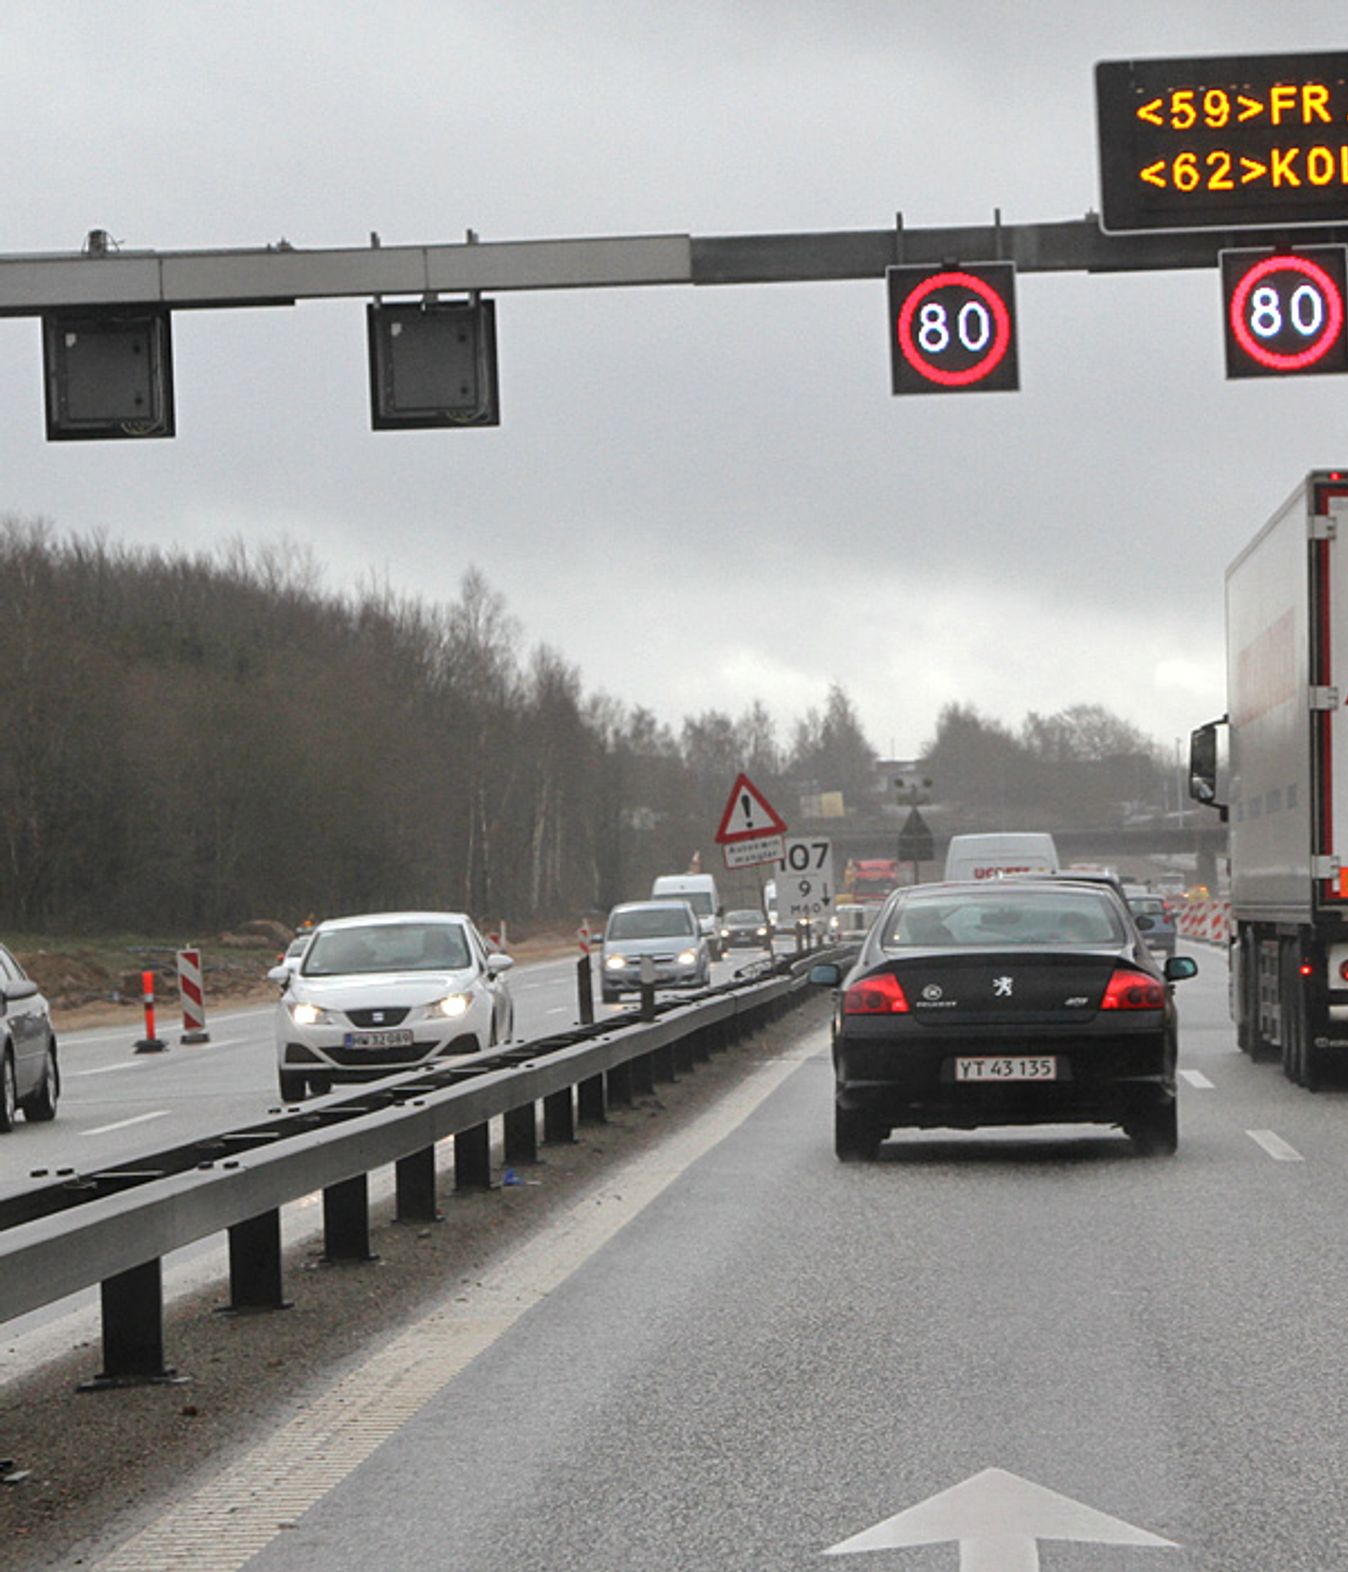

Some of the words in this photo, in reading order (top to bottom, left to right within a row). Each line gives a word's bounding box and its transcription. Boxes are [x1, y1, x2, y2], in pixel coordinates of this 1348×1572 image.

[918, 301, 990, 353] 80
[1250, 284, 1322, 337] 80
[799, 880, 812, 897] 9
[960, 1060, 985, 1077] YT
[990, 1060, 1013, 1076] 43
[1019, 1060, 1051, 1076] 135
